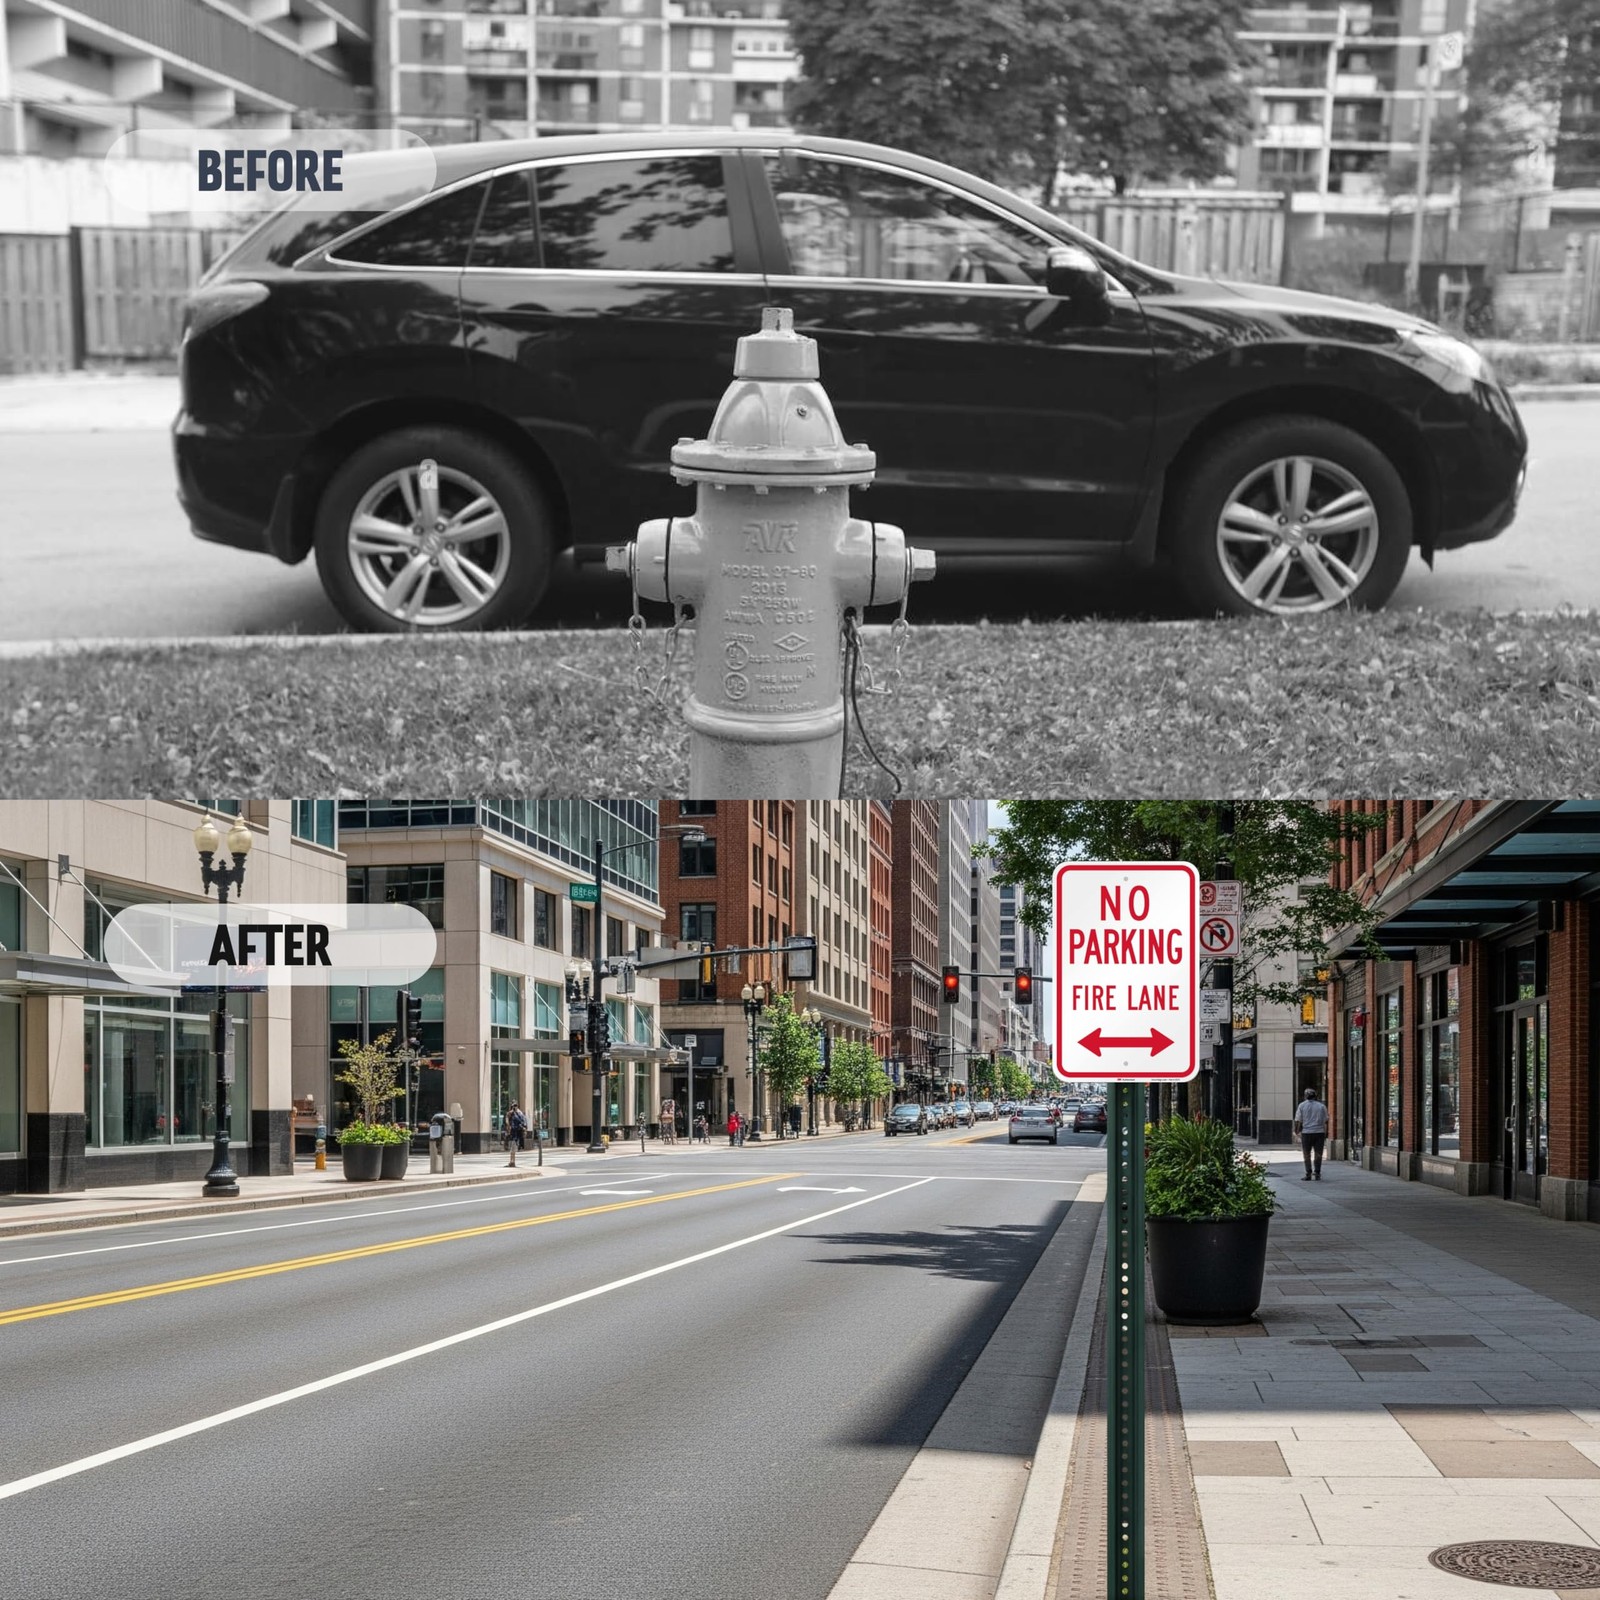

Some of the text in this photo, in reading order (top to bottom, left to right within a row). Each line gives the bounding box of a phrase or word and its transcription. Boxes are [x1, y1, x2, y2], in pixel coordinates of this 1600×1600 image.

[721, 563, 768, 579] MODEL
[1100, 885, 1150, 921] NO
[1069, 929, 1182, 964] PARKING
[1072, 985, 1116, 1010] FIRE
[1128, 985, 1179, 1010] LANE
